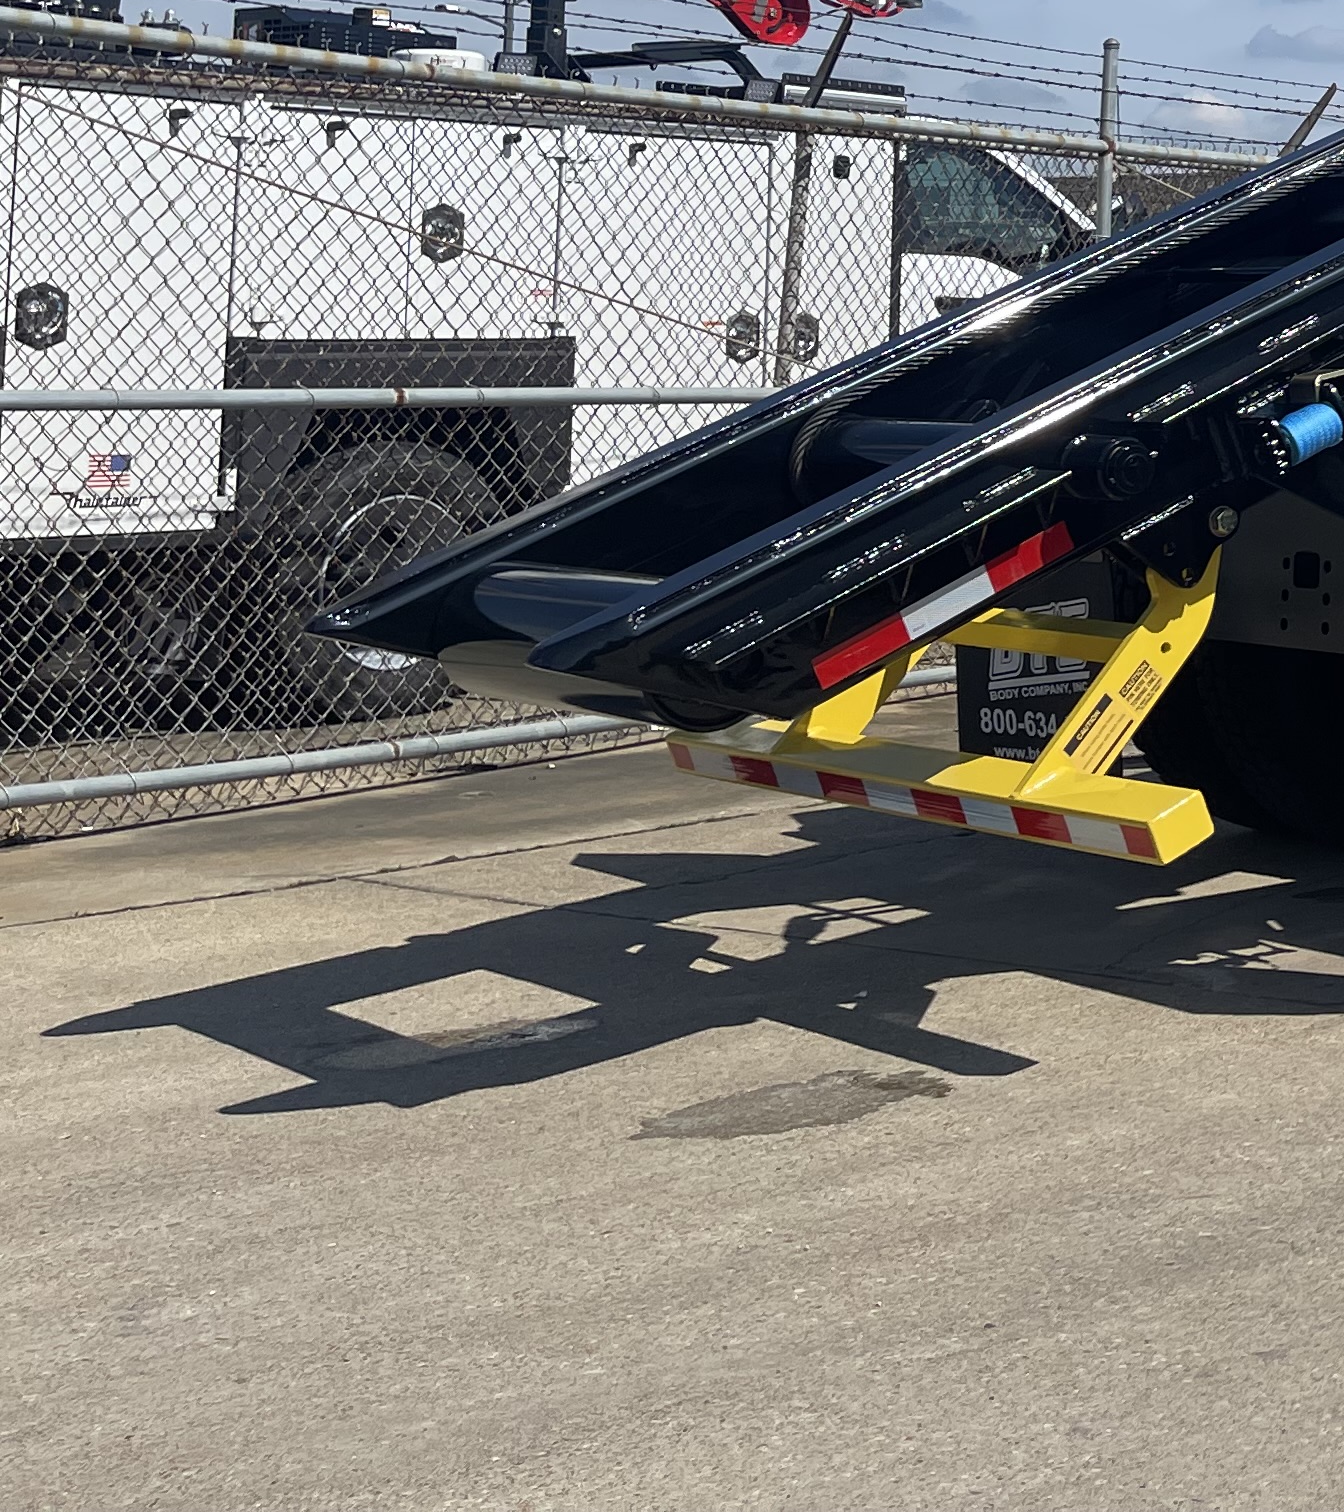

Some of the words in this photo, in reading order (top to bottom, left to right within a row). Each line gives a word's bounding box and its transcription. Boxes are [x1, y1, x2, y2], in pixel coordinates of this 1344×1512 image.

[990, 688, 1019, 702] BODY
[1021, 683, 1072, 698] COMPANY,
[1073, 681, 1088, 693] INC
[1120, 661, 1148, 696] CAUTION
[980, 707, 1058, 739] 800-634
[1075, 709, 1102, 741] CAUTION
